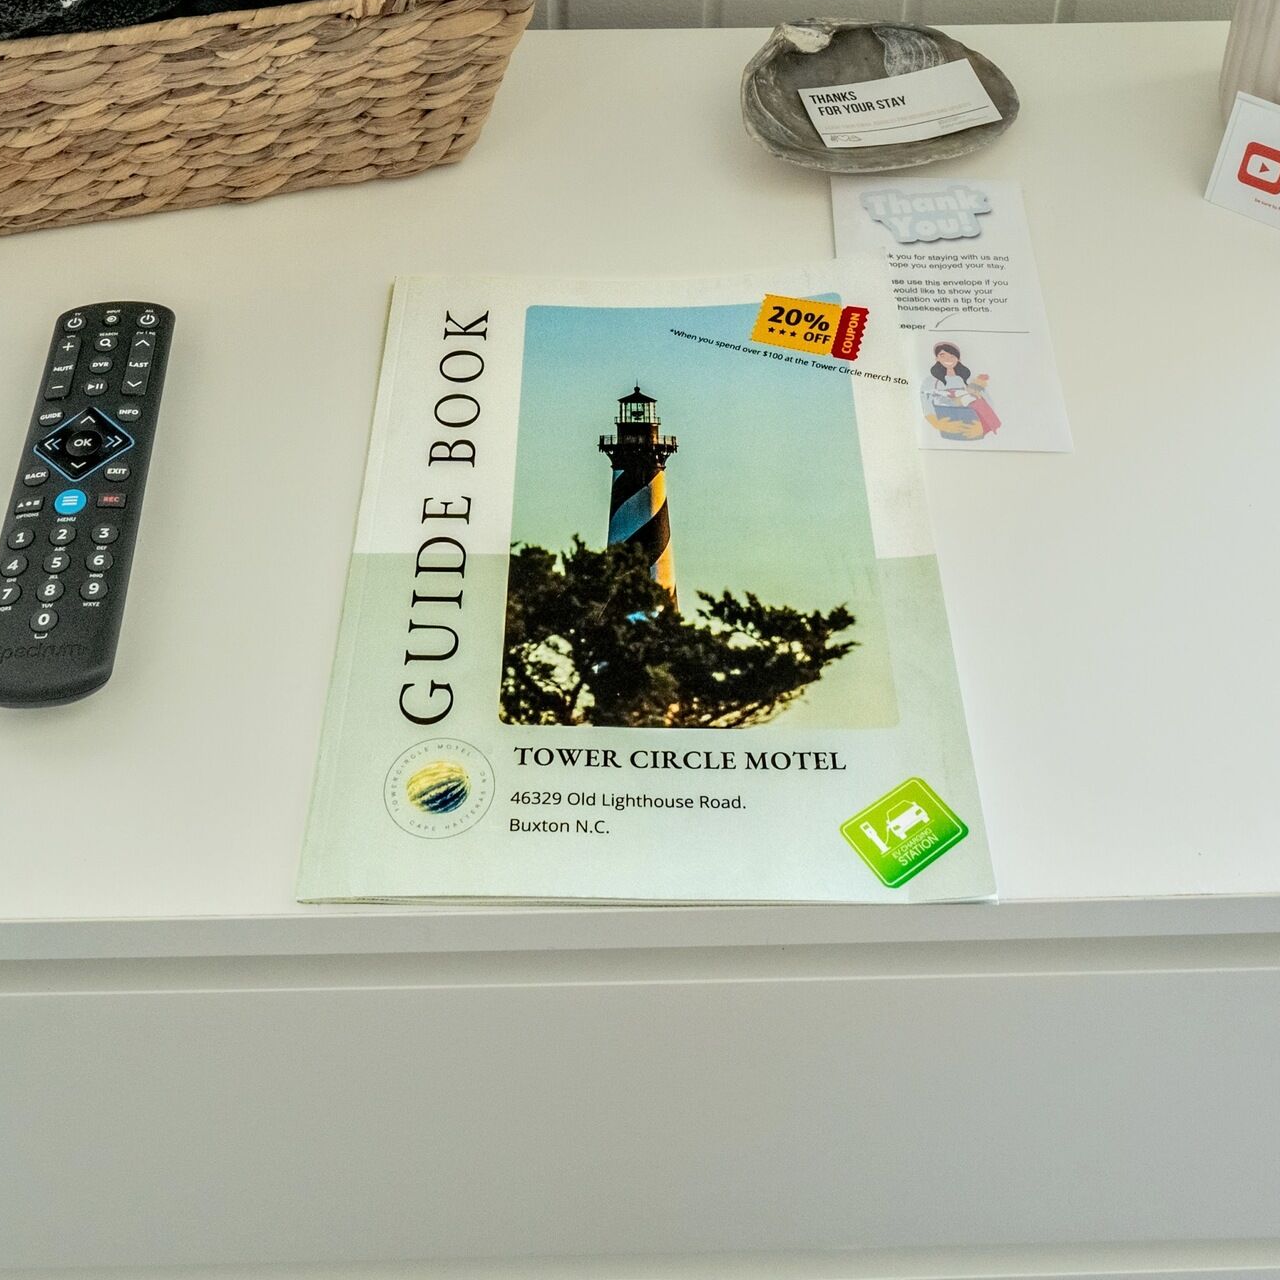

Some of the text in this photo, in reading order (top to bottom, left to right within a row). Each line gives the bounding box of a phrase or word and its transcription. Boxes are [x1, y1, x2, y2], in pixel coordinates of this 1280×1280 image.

[809, 91, 858, 105] THANKS
[817, 96, 906, 116] FOR YOUR STAY
[867, 188, 979, 216] Thank
[892, 209, 975, 239] You!
[928, 254, 958, 262] staying
[928, 262, 963, 270] enjoyed
[897, 304, 960, 313] housekeepers
[767, 305, 830, 332] 20%
[803, 332, 832, 344] OFF
[841, 312, 860, 354] COUPON
[698, 336, 714, 344] you
[715, 340, 741, 351] spend
[742, 346, 761, 356] over
[763, 350, 784, 360] $100
[795, 357, 808, 366] the
[811, 360, 838, 372] Tower
[838, 366, 862, 376] Circle
[864, 371, 892, 382] merch
[893, 377, 909, 386] sto
[52, 364, 74, 372] MUTE
[40, 412, 62, 420] GUIDE
[73, 438, 93, 447] OK
[24, 471, 47, 480] BACK
[16, 512, 39, 520] OPTIONS
[399, 310, 490, 726] GUIDE BOOK
[16, 532, 25, 544] 1
[56, 529, 68, 540] 2
[99, 528, 110, 538] 3
[7, 560, 18, 570] 4
[51, 557, 62, 568] 5
[93, 555, 104, 566] 6
[2, 588, 12, 600] 7
[44, 584, 56, 596] 8
[88, 582, 100, 594] 9
[38, 614, 50, 626] 0
[514, 746, 847, 770] TOWER CIRCLE MOTEL
[510, 792, 747, 811] 46329 Old Lighthouse Road.
[510, 818, 610, 834] Buxton N.C.
[898, 832, 939, 866] STATION
